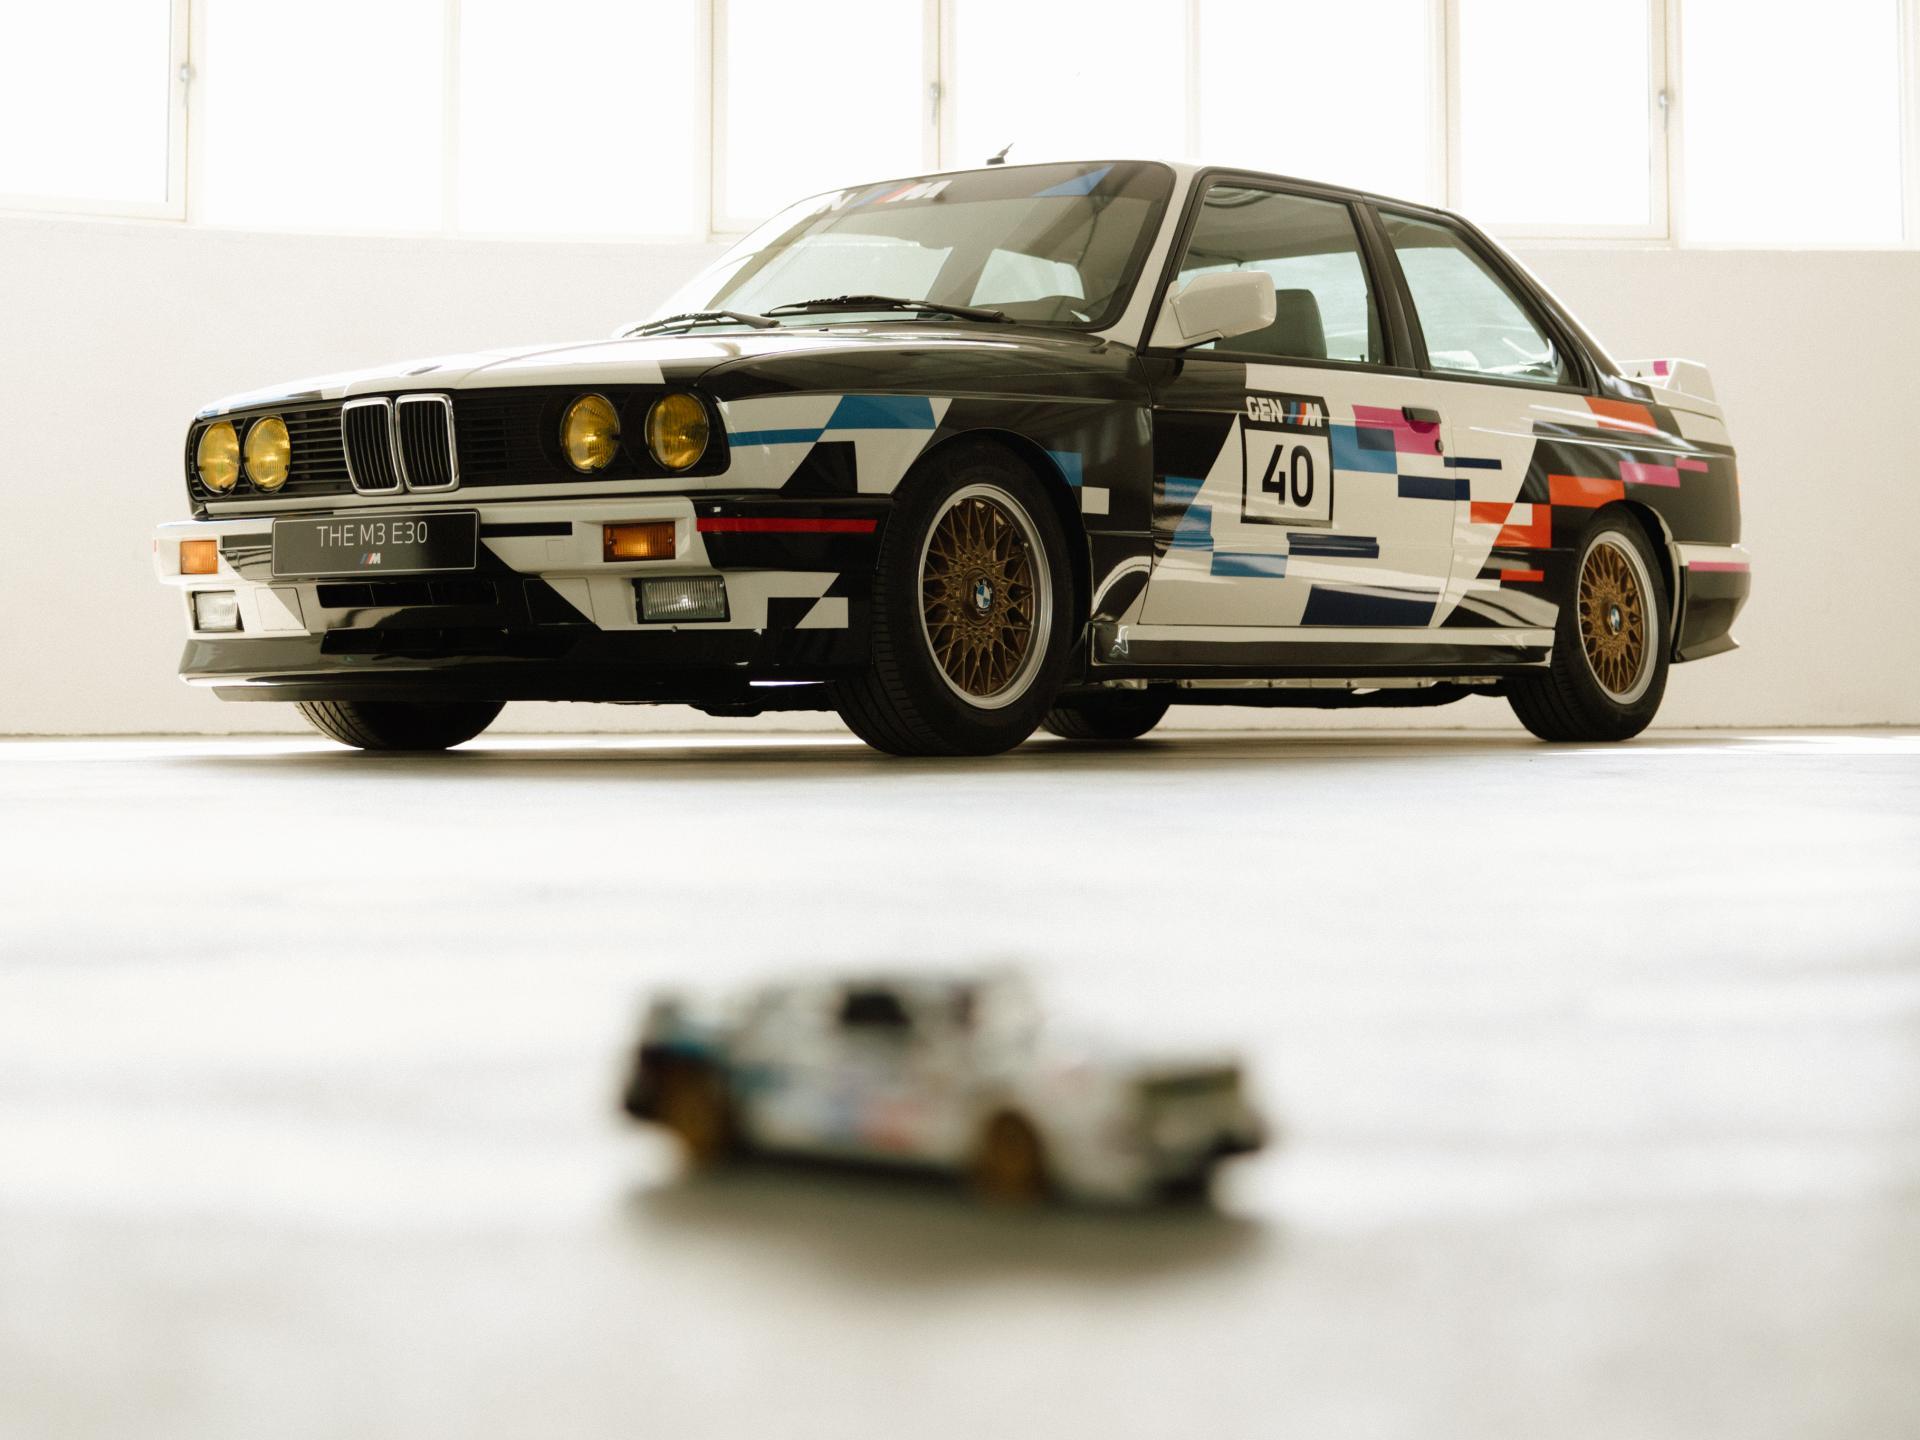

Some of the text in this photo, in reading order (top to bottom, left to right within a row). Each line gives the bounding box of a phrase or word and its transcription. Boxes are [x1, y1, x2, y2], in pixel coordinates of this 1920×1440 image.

[1246, 396, 1283, 423] GEN
[1262, 444, 1314, 507] 40
[316, 521, 428, 547] THE M3 E30
